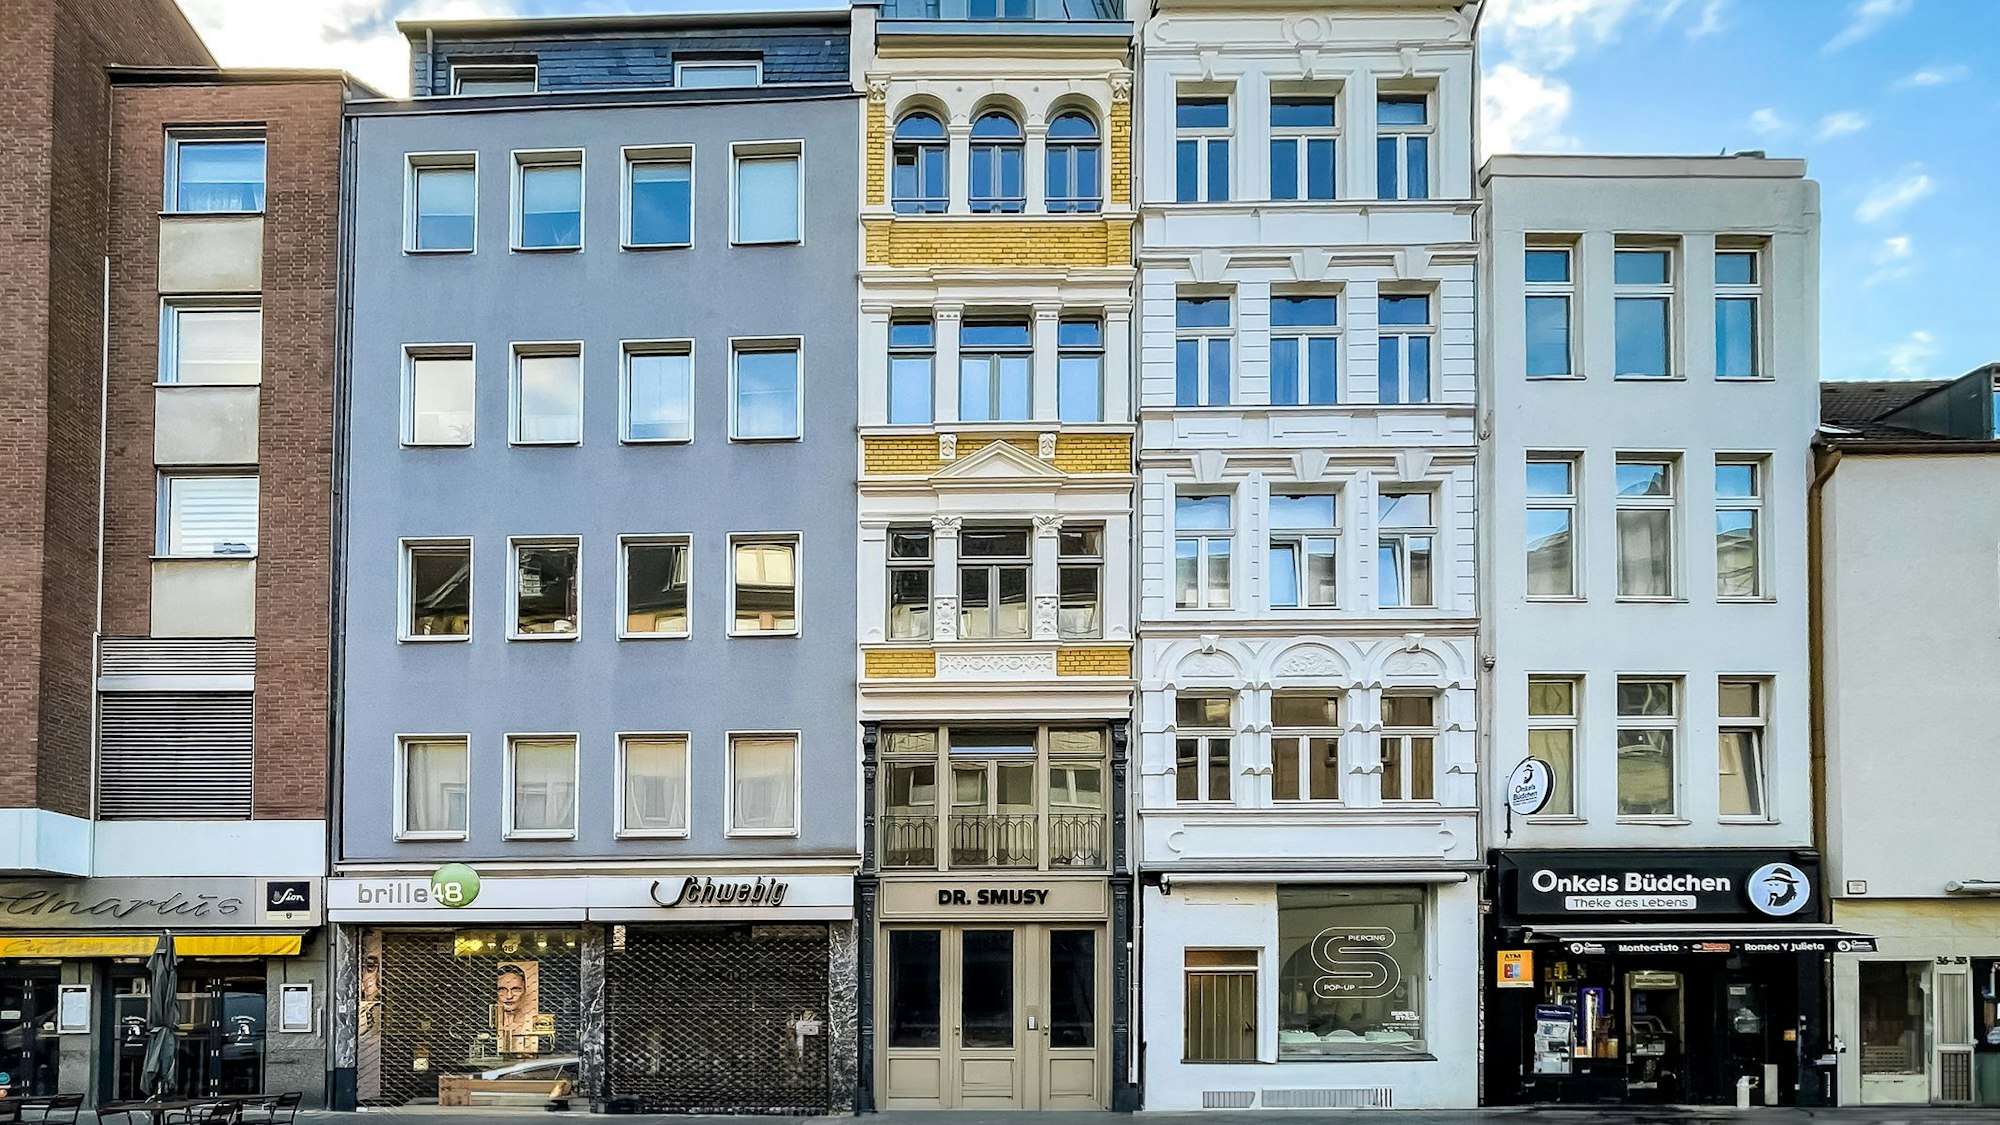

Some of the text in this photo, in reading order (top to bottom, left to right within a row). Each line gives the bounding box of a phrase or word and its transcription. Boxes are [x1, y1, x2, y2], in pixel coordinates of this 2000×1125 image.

[1532, 869, 1731, 893] Onkels Büdchen
[271, 888, 305, 905] Sion
[650, 876, 788, 907] Schwebig
[938, 889, 1049, 905] DR. SMUSY
[1573, 898, 1688, 908] Theke des Lebens
[1618, 943, 1679, 952] Montecristo
[1744, 942, 1825, 951] Romeo Y Julieta
